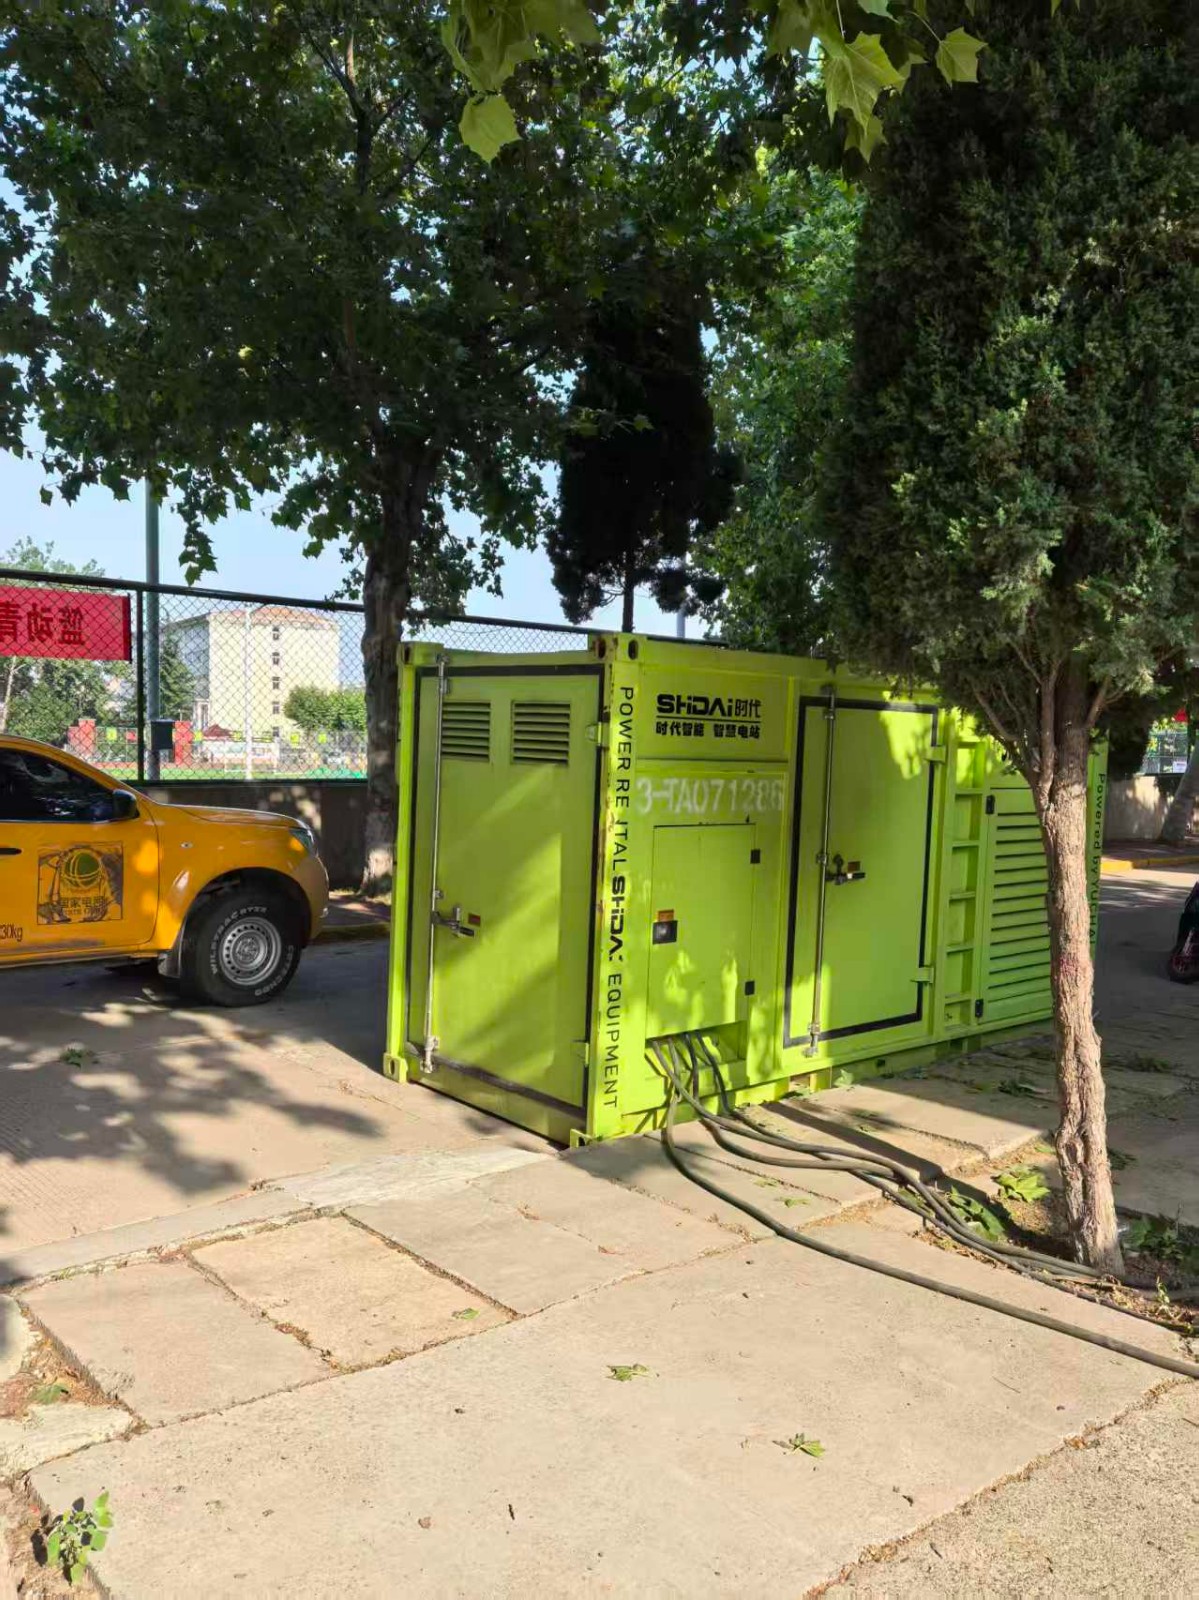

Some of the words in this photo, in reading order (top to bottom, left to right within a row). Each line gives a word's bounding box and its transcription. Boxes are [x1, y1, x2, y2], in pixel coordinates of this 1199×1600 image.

[617, 686, 634, 770] POWER
[656, 721, 705, 736] 时代智能
[713, 723, 761, 739] 智慧电站
[1093, 773, 1106, 850] Powered
[603, 973, 622, 1108] EQUIPMENT
